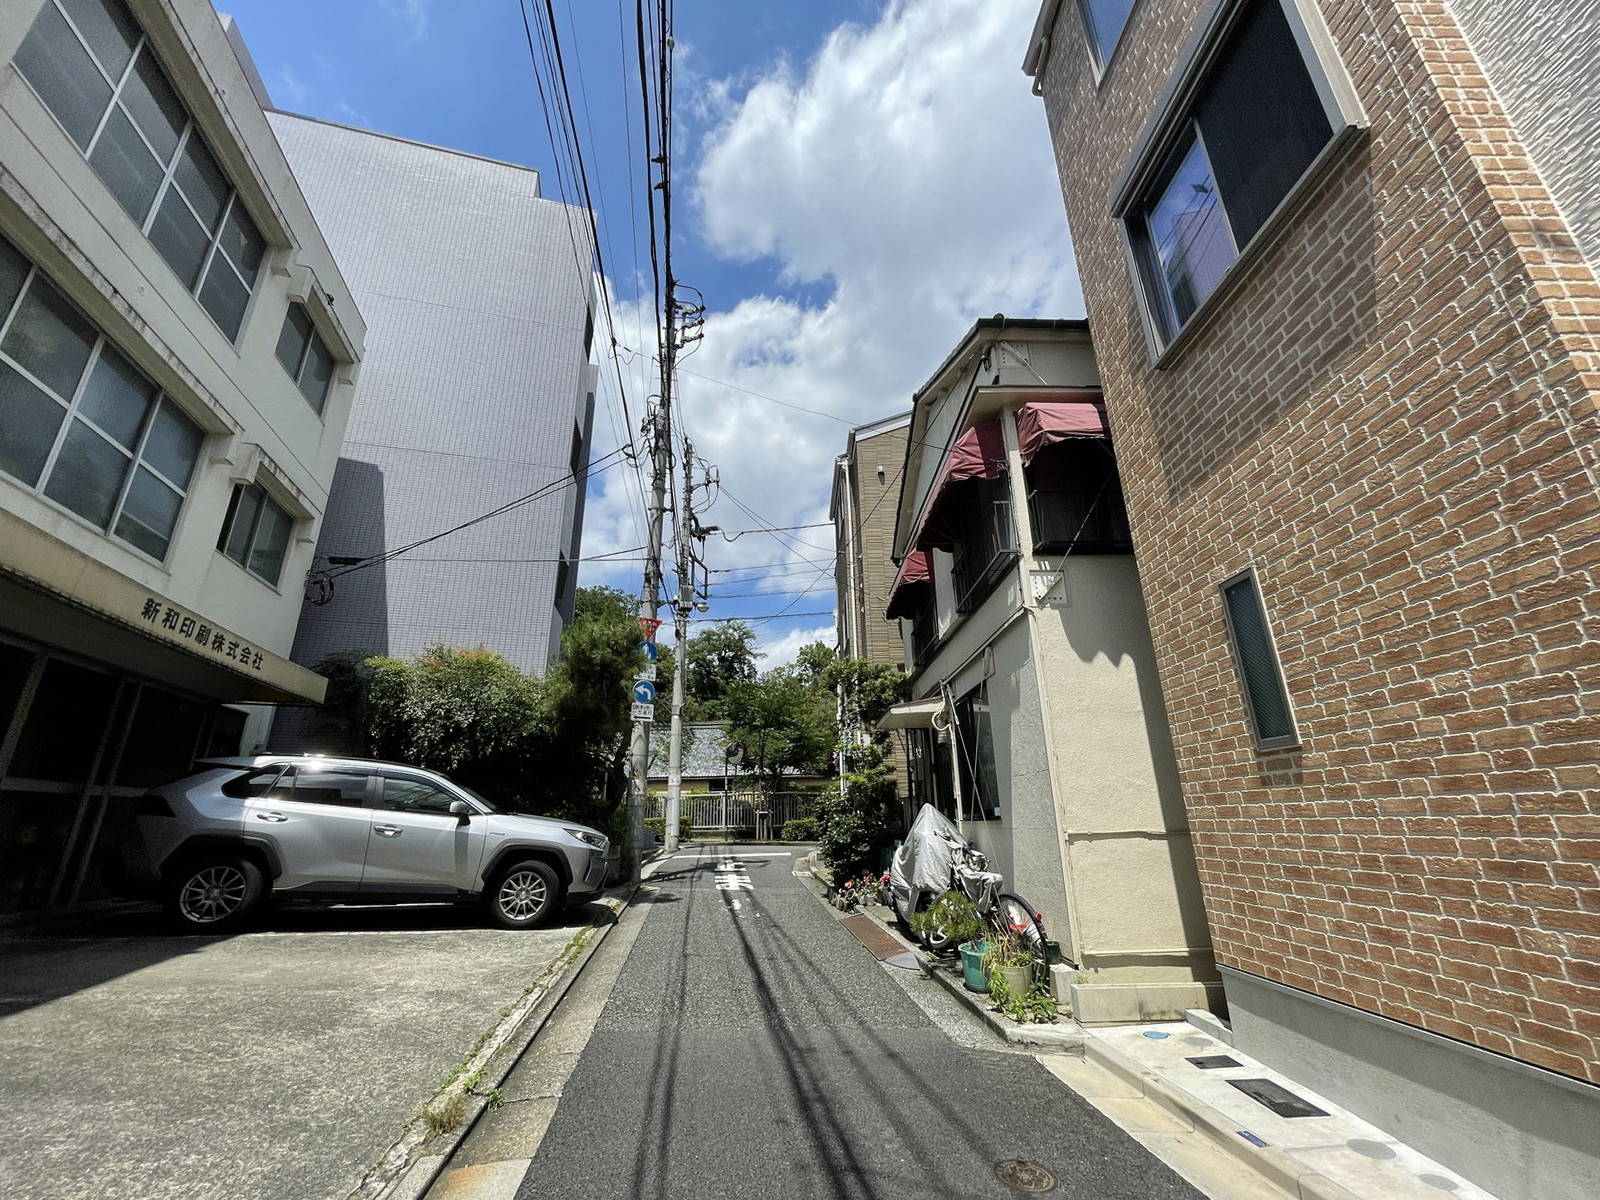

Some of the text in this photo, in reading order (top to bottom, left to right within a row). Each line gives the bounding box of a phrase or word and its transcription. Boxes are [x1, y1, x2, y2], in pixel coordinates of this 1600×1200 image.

[141, 598, 264, 671] 新和印刷株式会社
